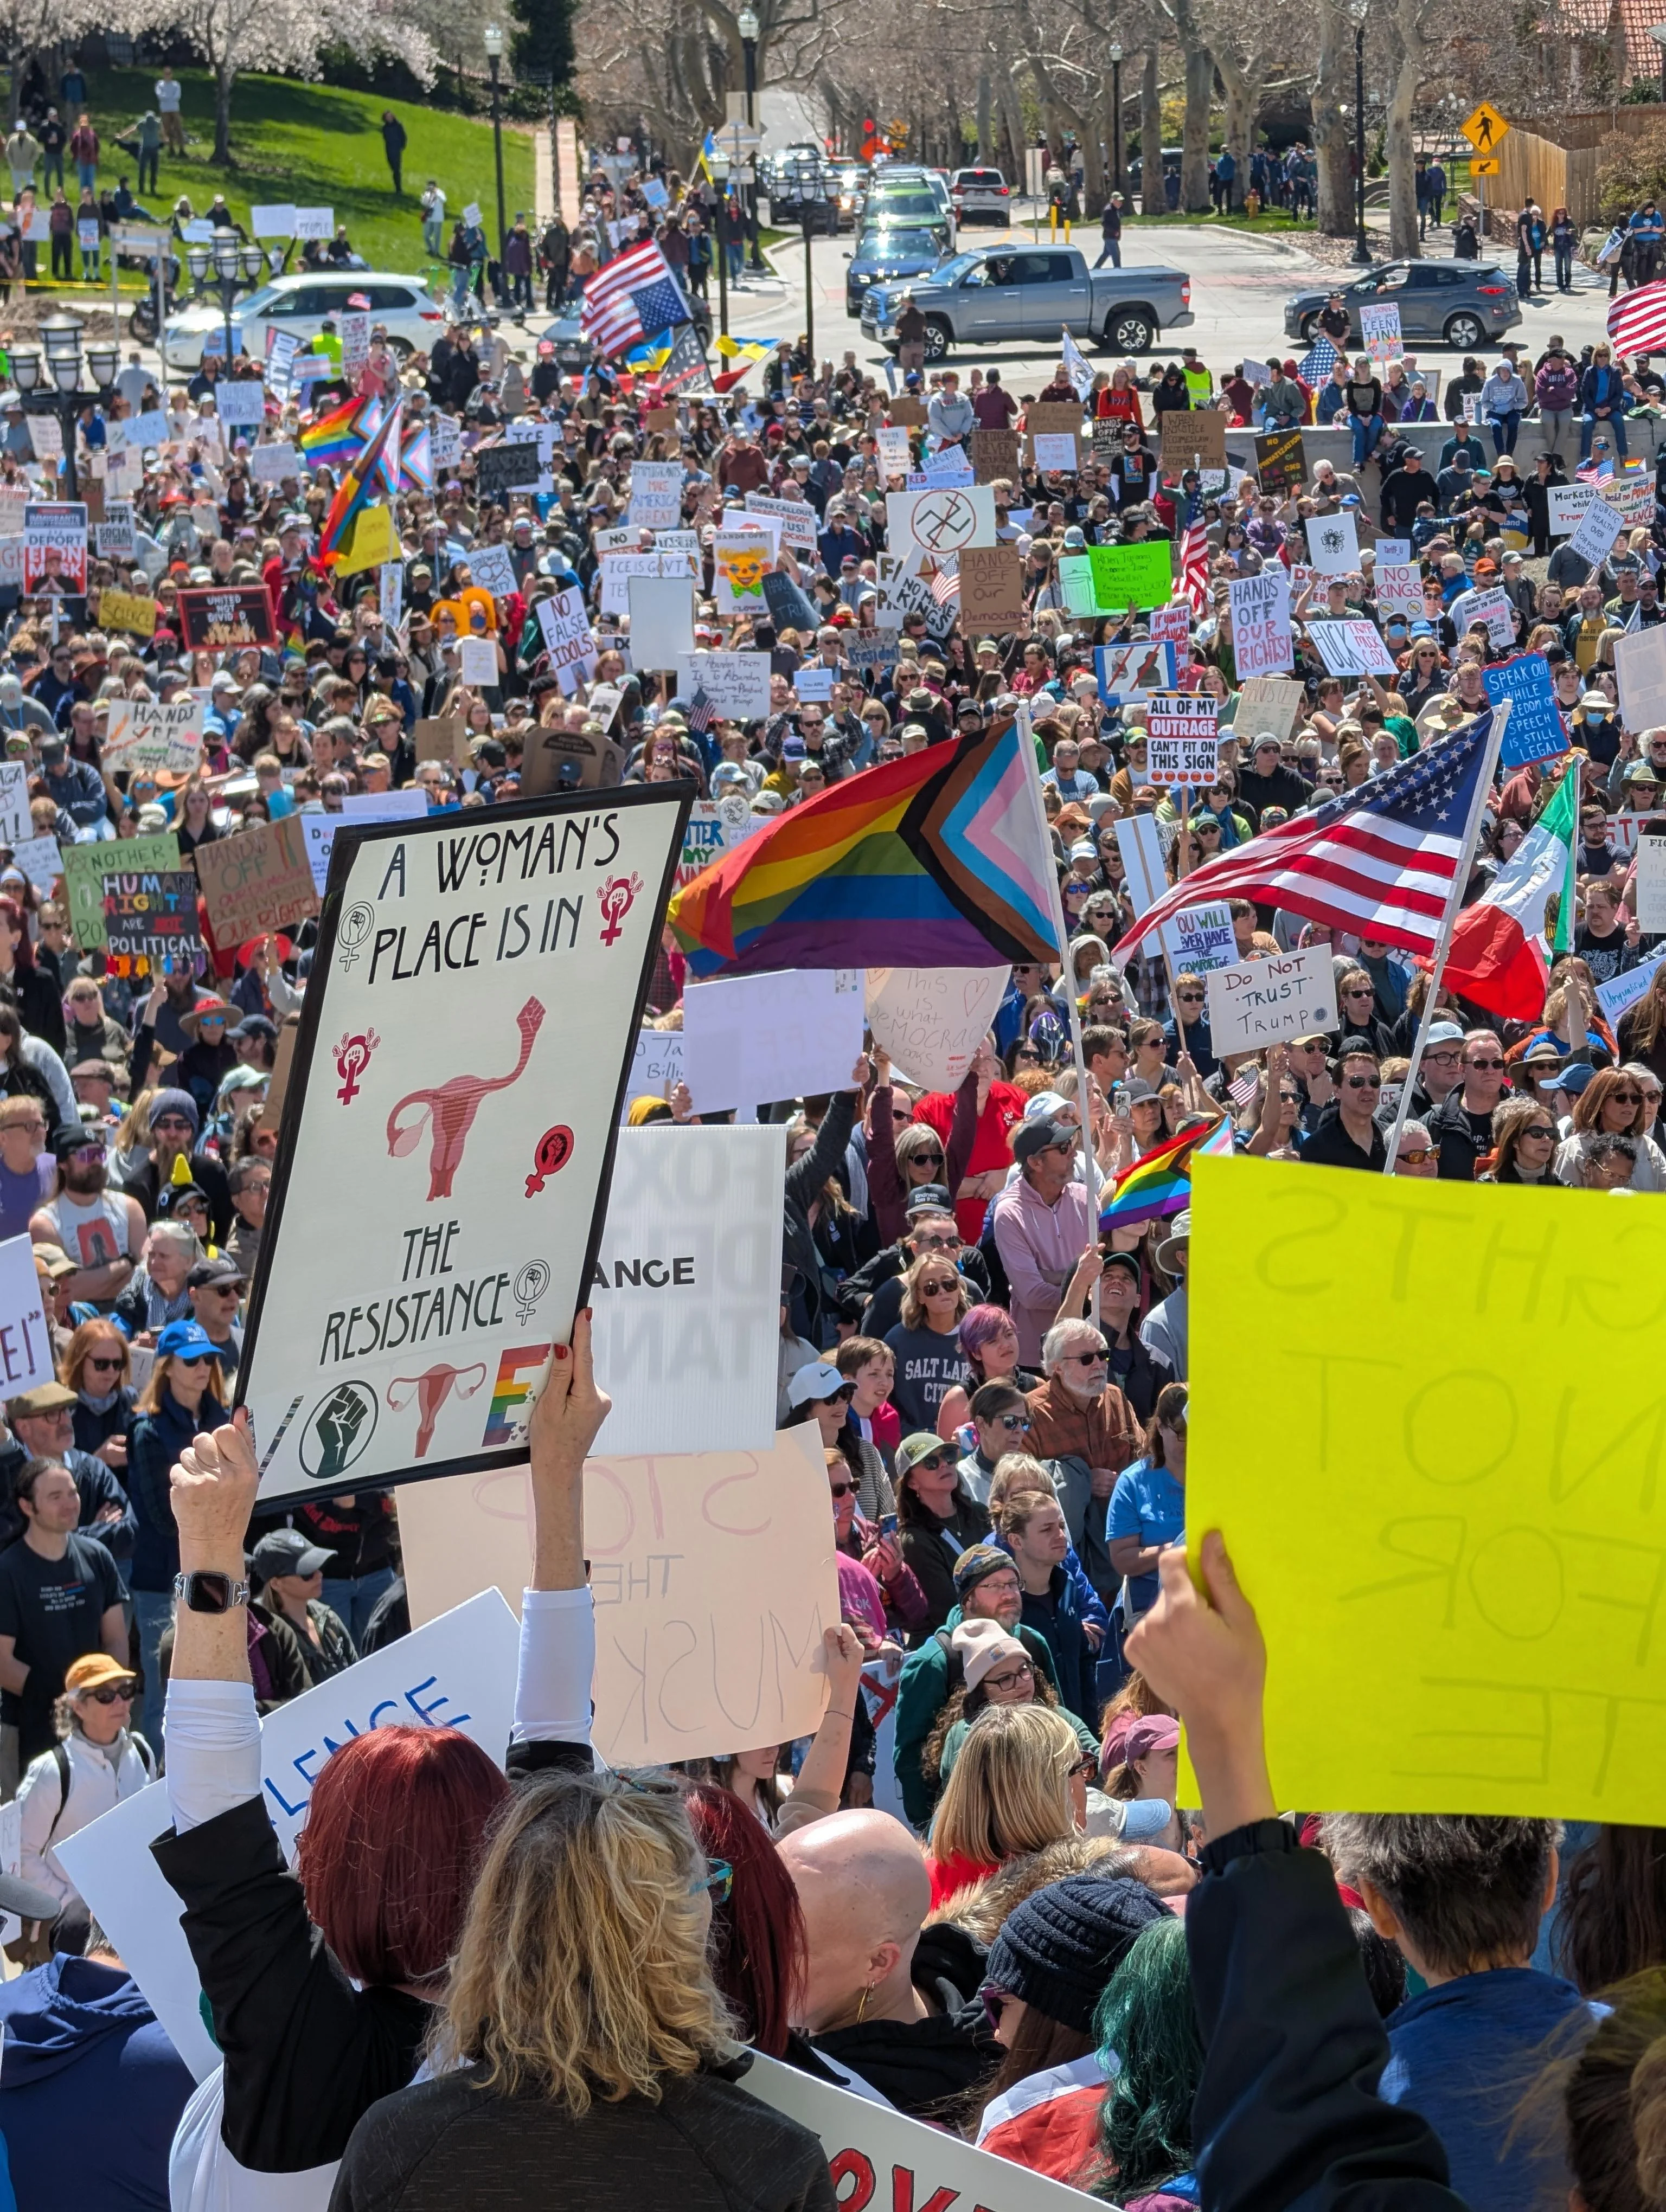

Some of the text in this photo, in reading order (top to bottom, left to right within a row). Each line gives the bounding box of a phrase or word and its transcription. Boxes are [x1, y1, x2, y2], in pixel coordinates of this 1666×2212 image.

[1362, 317, 1398, 331] TEENY
[1365, 329, 1398, 342] TINY
[1168, 414, 1195, 425] WHEN
[634, 509, 674, 524] GREAT
[1591, 512, 1615, 532] HEALTH
[1594, 503, 1620, 524] PUBLIC
[29, 534, 82, 546] DEPORT
[609, 533, 629, 547] NO
[1590, 525, 1605, 539] OVER
[1575, 542, 1600, 564] WEALTH
[1576, 529, 1609, 557] CORPORATE
[610, 561, 633, 574] ICE
[963, 551, 1020, 570] HANDS
[974, 570, 1009, 582] OFF
[1383, 567, 1409, 582] NO
[902, 577, 921, 595] NO
[1233, 575, 1280, 606] HANDS
[1375, 583, 1422, 599] KINGS
[549, 593, 571, 621] NO
[896, 588, 950, 632] KINGS
[1238, 600, 1276, 626] OFF
[546, 612, 587, 647] FALSE
[858, 628, 880, 639] NOT
[1237, 620, 1276, 645] OUR
[1345, 621, 1373, 635] TRUMP
[552, 633, 594, 670] IDOLS
[1238, 634, 1291, 672] RIGHTS!
[1308, 622, 1370, 671] FUCK
[1361, 649, 1391, 667] COX
[1488, 659, 1548, 691] SPEAK OUT
[1503, 683, 1541, 702] WHILE
[1543, 695, 1555, 707] OF
[133, 704, 197, 725] HANDS
[1151, 700, 1215, 715] ALL OF MY
[1151, 719, 1215, 736] OUTRAGE
[1509, 712, 1552, 736] SPEECH
[1151, 741, 1215, 754] CAN'T FIT ON
[1509, 728, 1557, 749] IS STILL
[1151, 754, 1215, 769] THIS SIGN
[1519, 740, 1564, 762] LEGAL
[378, 844, 406, 901] A
[437, 813, 620, 894] WOMAN'S
[683, 847, 715, 864] DAY
[221, 853, 267, 892] OFF
[103, 873, 195, 896] HUMAN
[103, 893, 194, 917] RIGHTS
[122, 917, 145, 931] ARE
[1176, 909, 1230, 934] OU WILL
[109, 933, 203, 955] POLITICAL
[367, 895, 585, 986] PLACE IS IN
[1204, 927, 1233, 945] HAVE
[1195, 949, 1213, 959] THE
[1178, 957, 1220, 974] COMFORT
[898, 968, 947, 994] This
[401, 1219, 462, 1283] THE
[591, 1256, 696, 1290] ANCE
[319, 1271, 511, 1366] RESISTANCE
[905, 1358, 940, 1380] SALT
[924, 1382, 952, 1403] CIT
